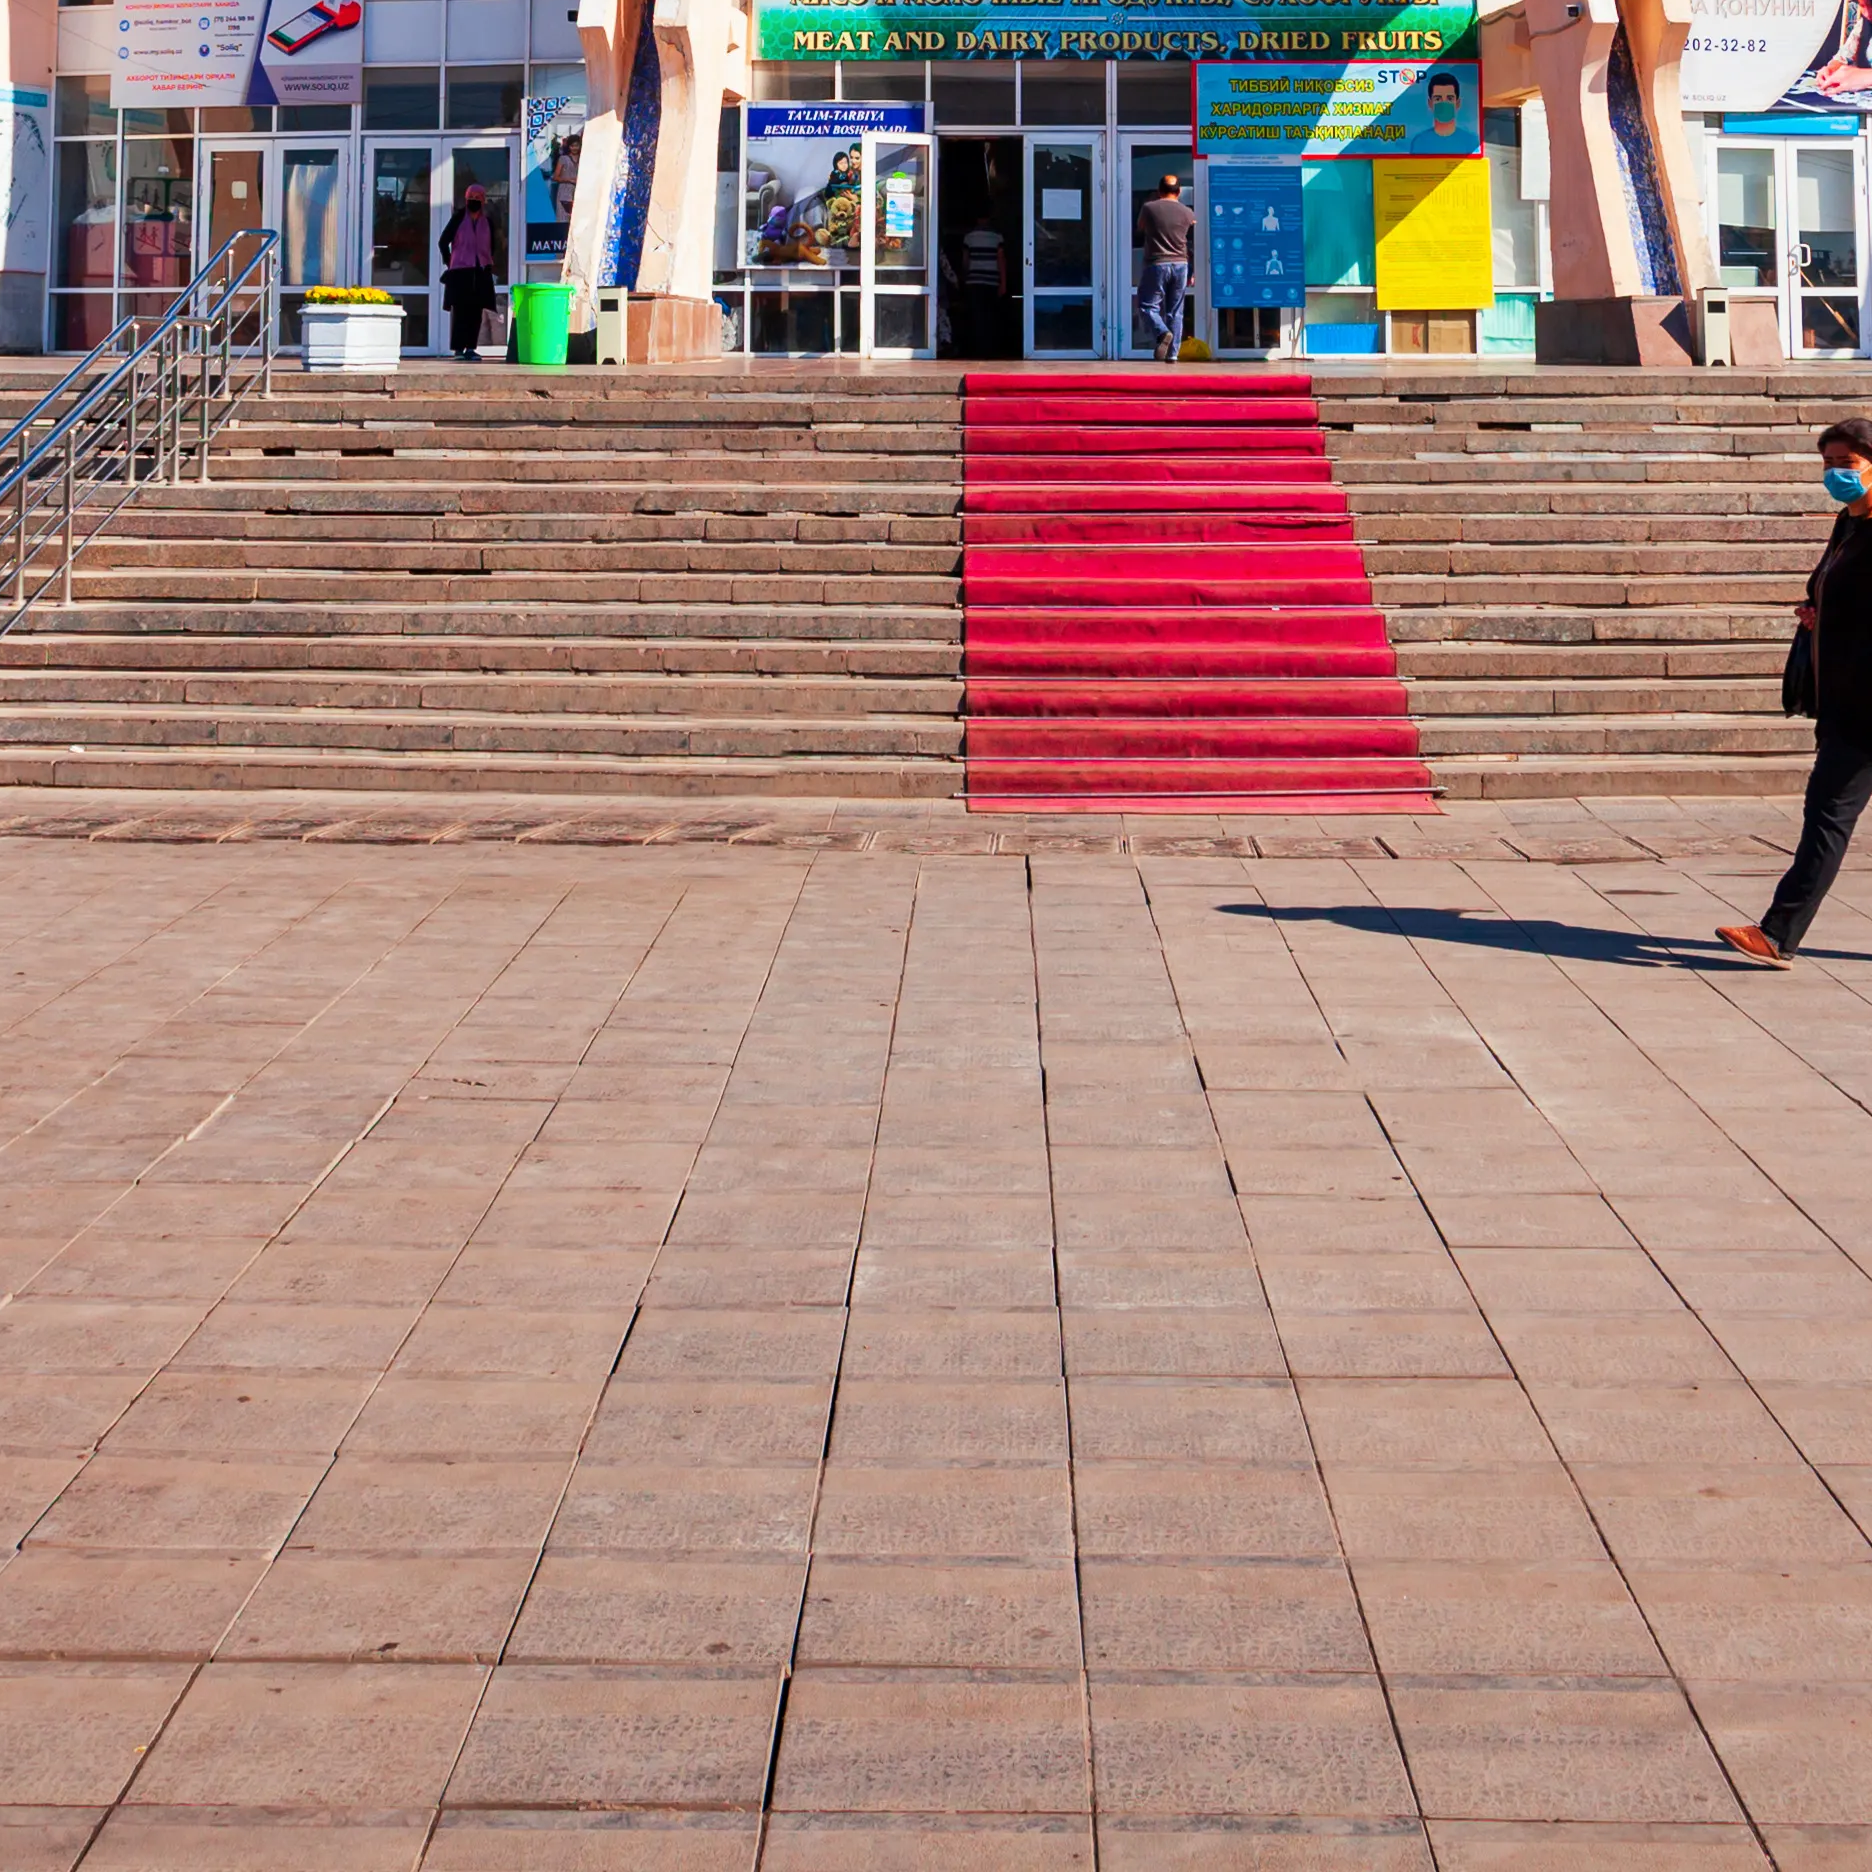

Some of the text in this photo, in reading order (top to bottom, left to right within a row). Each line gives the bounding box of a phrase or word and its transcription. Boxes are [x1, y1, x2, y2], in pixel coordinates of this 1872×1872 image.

[793, 30, 1444, 54] MEAT AND DAIRY PRODUCTS, DRIED FRUITS
[1229, 76, 1375, 94] ТИББИЙ НИҚОБСИЗ
[1211, 102, 1393, 117] ХАРИДОРЛАРГА ХИЗМАТ
[763, 125, 830, 135] BESHIKDAN
[1200, 122, 1406, 141] КЎРСАТИШ ТАЪҚИҚЛАНАДИ
